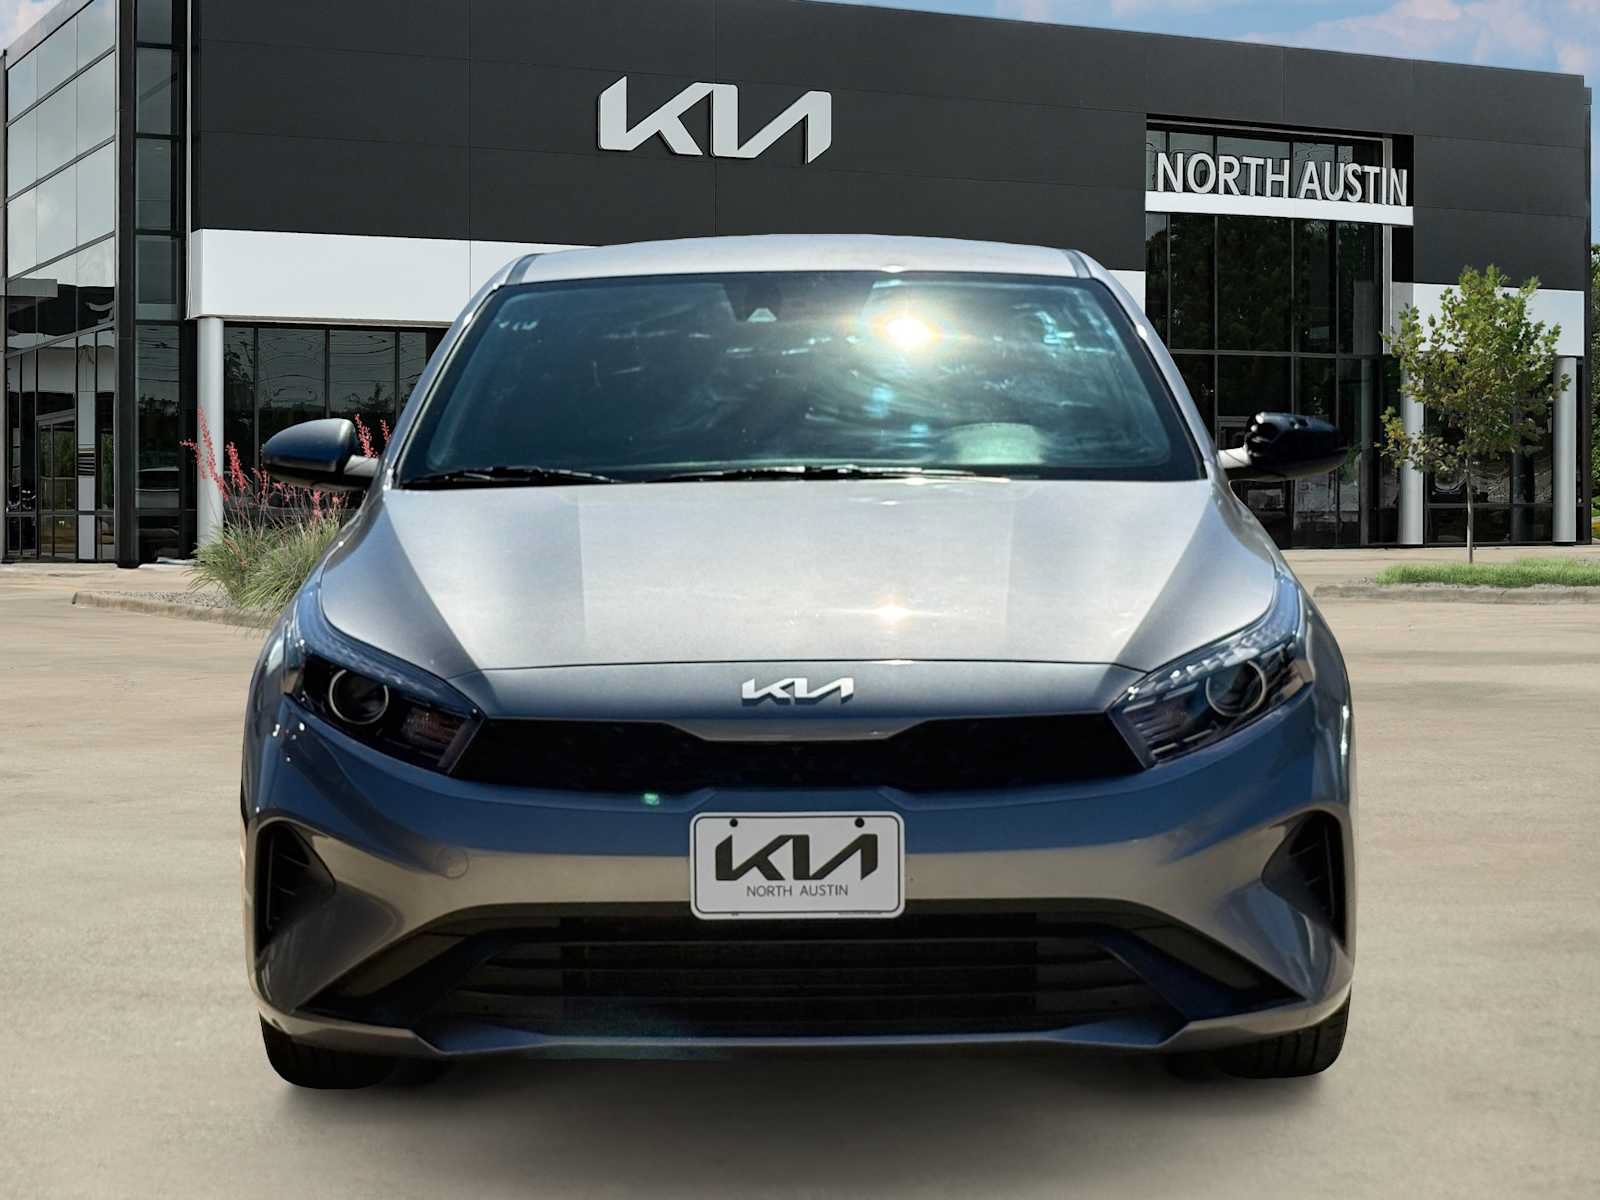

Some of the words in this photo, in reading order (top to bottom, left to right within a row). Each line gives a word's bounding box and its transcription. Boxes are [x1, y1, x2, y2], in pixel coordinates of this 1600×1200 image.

[598, 75, 832, 164] KIA
[1156, 152, 1291, 198] NORTH
[1298, 160, 1408, 206] AUSTIN
[741, 677, 855, 704] KIA
[714, 833, 879, 881] KIA
[746, 885, 793, 898] NORTH
[799, 884, 849, 897] AUSTIN
